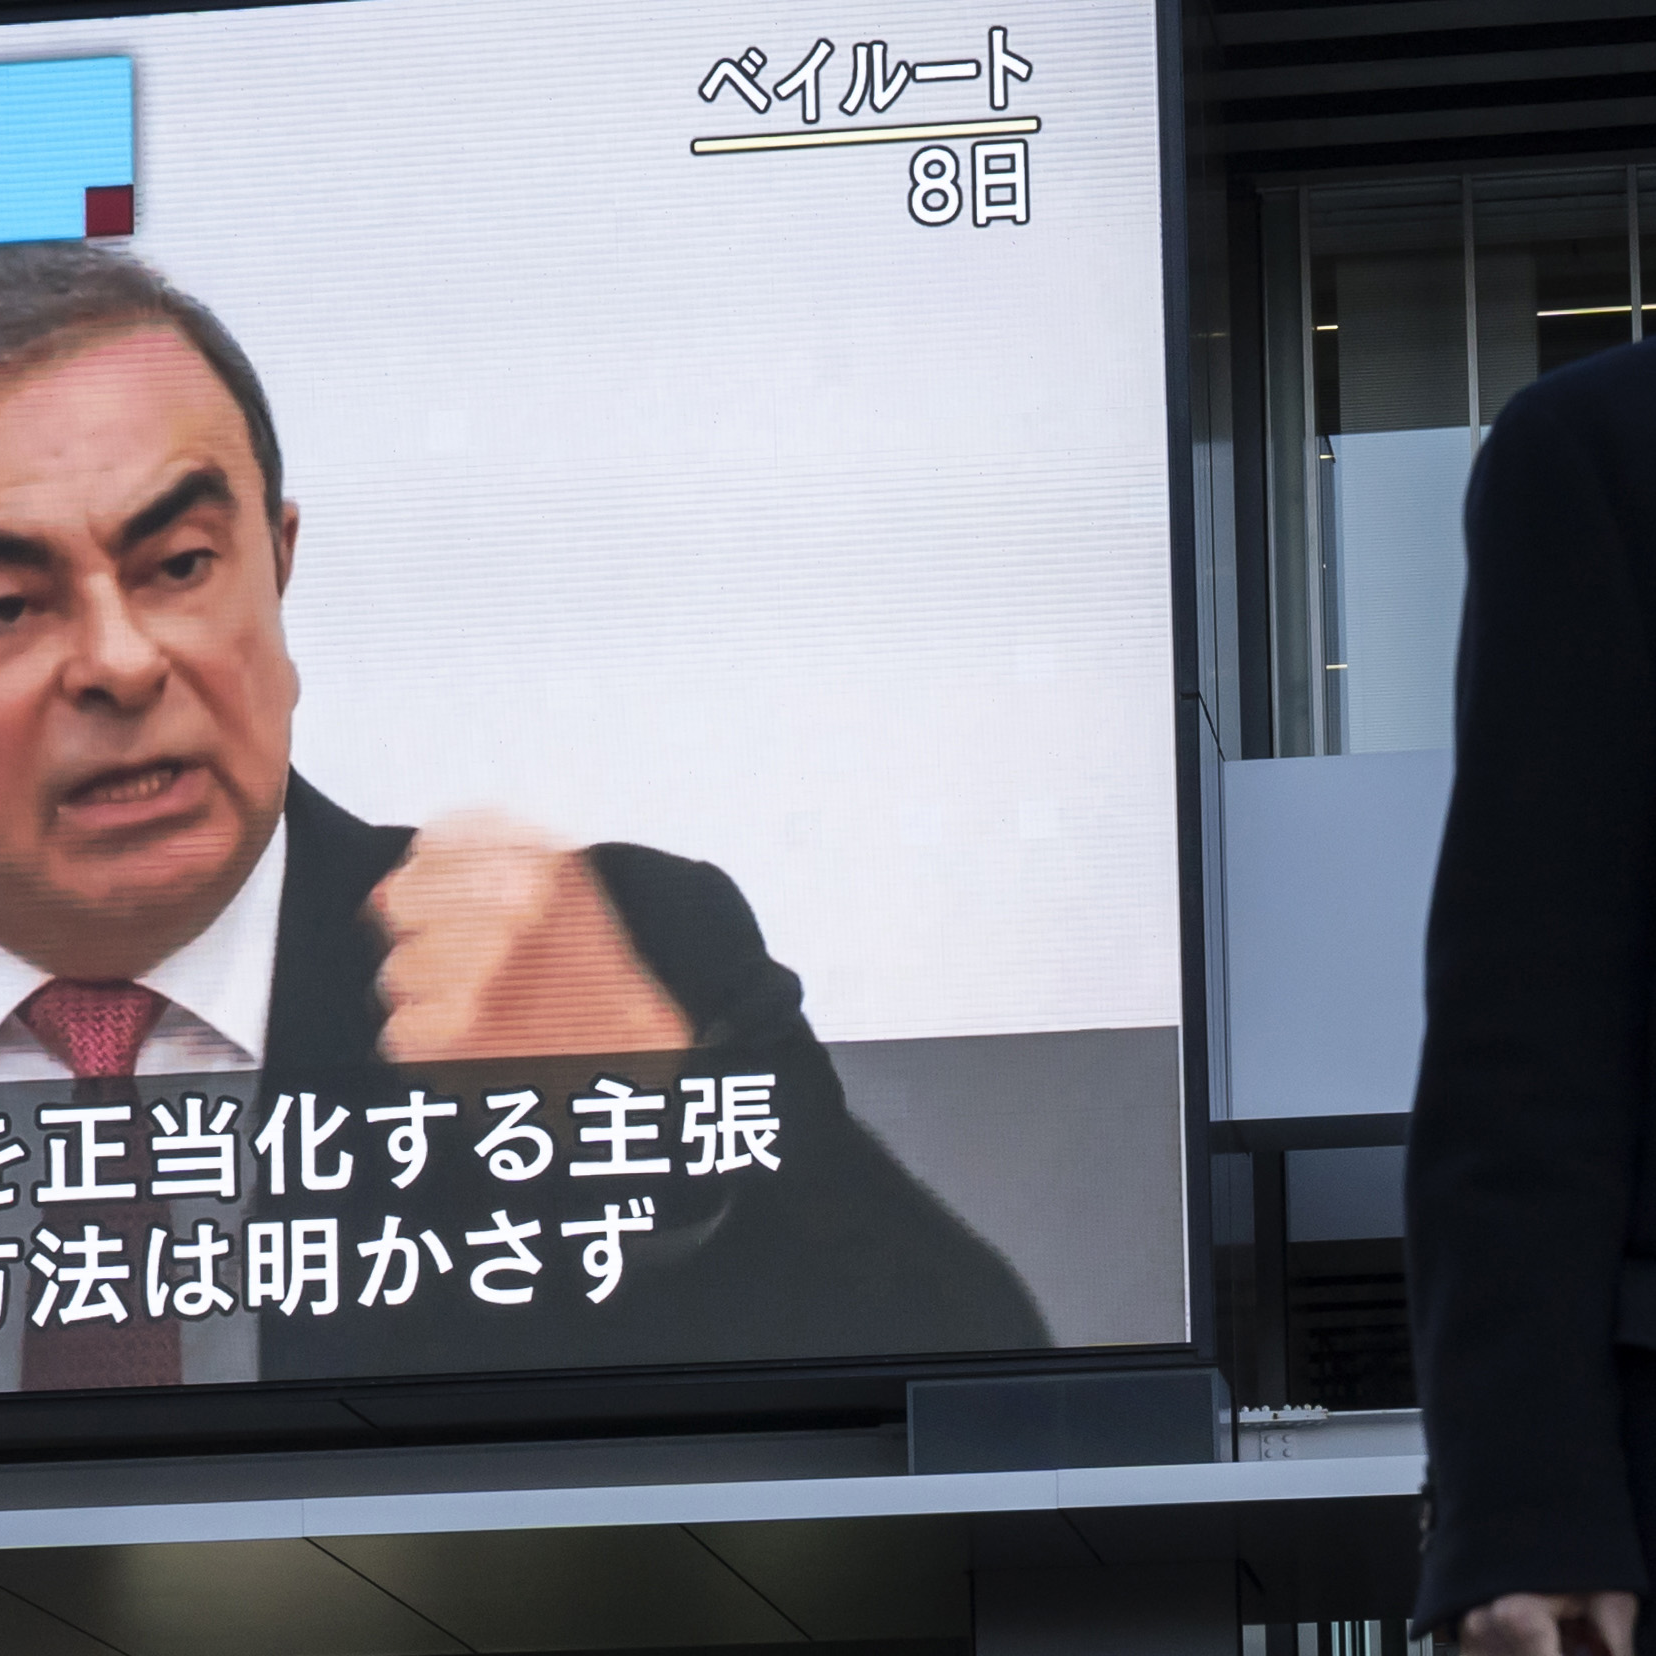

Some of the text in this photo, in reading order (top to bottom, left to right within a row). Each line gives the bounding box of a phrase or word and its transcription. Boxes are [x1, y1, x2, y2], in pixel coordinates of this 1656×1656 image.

[700, 27, 1032, 124] ベイルート
[908, 139, 1030, 227] 8日
